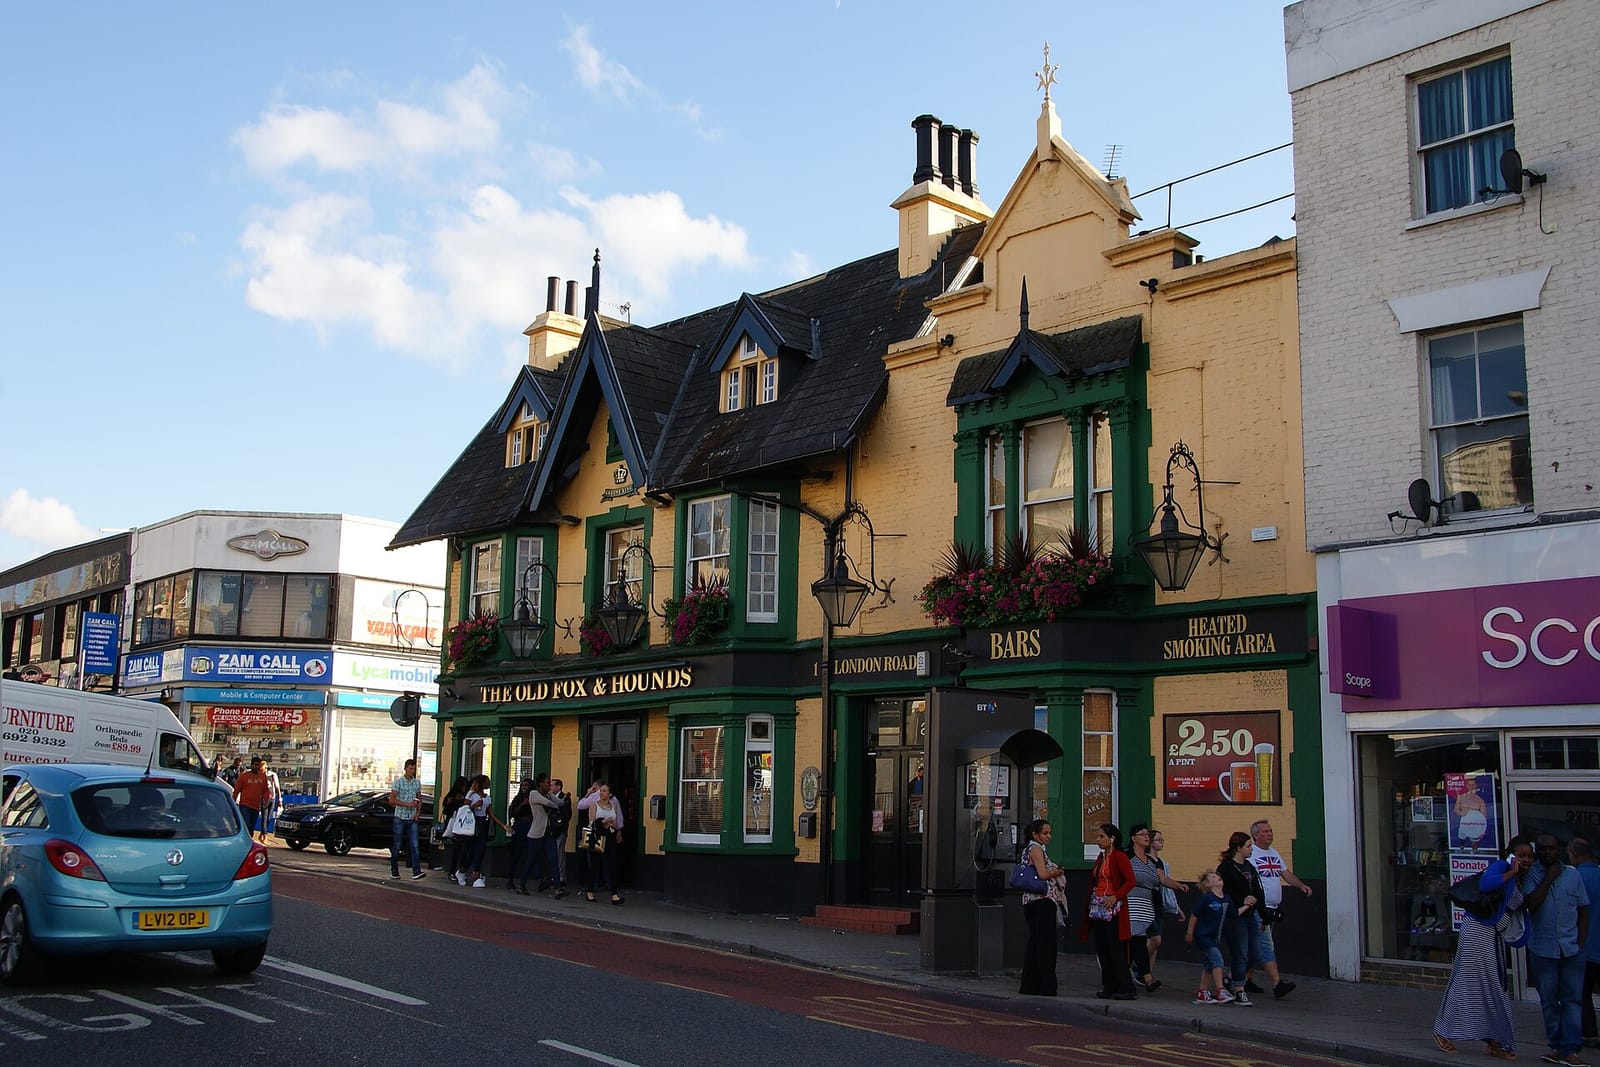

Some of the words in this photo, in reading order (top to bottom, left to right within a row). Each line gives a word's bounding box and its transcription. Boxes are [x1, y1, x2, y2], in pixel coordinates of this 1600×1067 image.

[1188, 614, 1247, 638] HEATED
[990, 628, 1041, 660] BARS
[1163, 637, 1230, 660] SMOKING
[1234, 633, 1276, 654] AREA
[129, 658, 142, 672] ZAM
[144, 656, 160, 671] CALL
[218, 654, 254, 668] ZAM
[260, 655, 300, 668] CALL
[834, 657, 882, 675] LONDON
[884, 654, 916, 672] ROAD
[480, 686, 512, 702] THE
[515, 682, 548, 701] OLD
[552, 678, 588, 699] FOX
[593, 677, 606, 696] &
[611, 667, 692, 694] HOUNDS
[1346, 672, 1371, 689] Scope
[242, 708, 284, 716] Unlocking
[977, 704, 988, 712] BT
[284, 710, 303, 724] £5
[96, 725, 143, 738] Orthopaedic
[110, 735, 128, 743] Beds
[1168, 719, 1254, 757] £2.50
[3, 732, 28, 742] 692
[33, 736, 66, 747] 9332
[111, 743, 141, 753] £89.99
[1087, 802, 1105, 814] AREA
[1452, 860, 1486, 869] Donate
[145, 912, 175, 927] LV12
